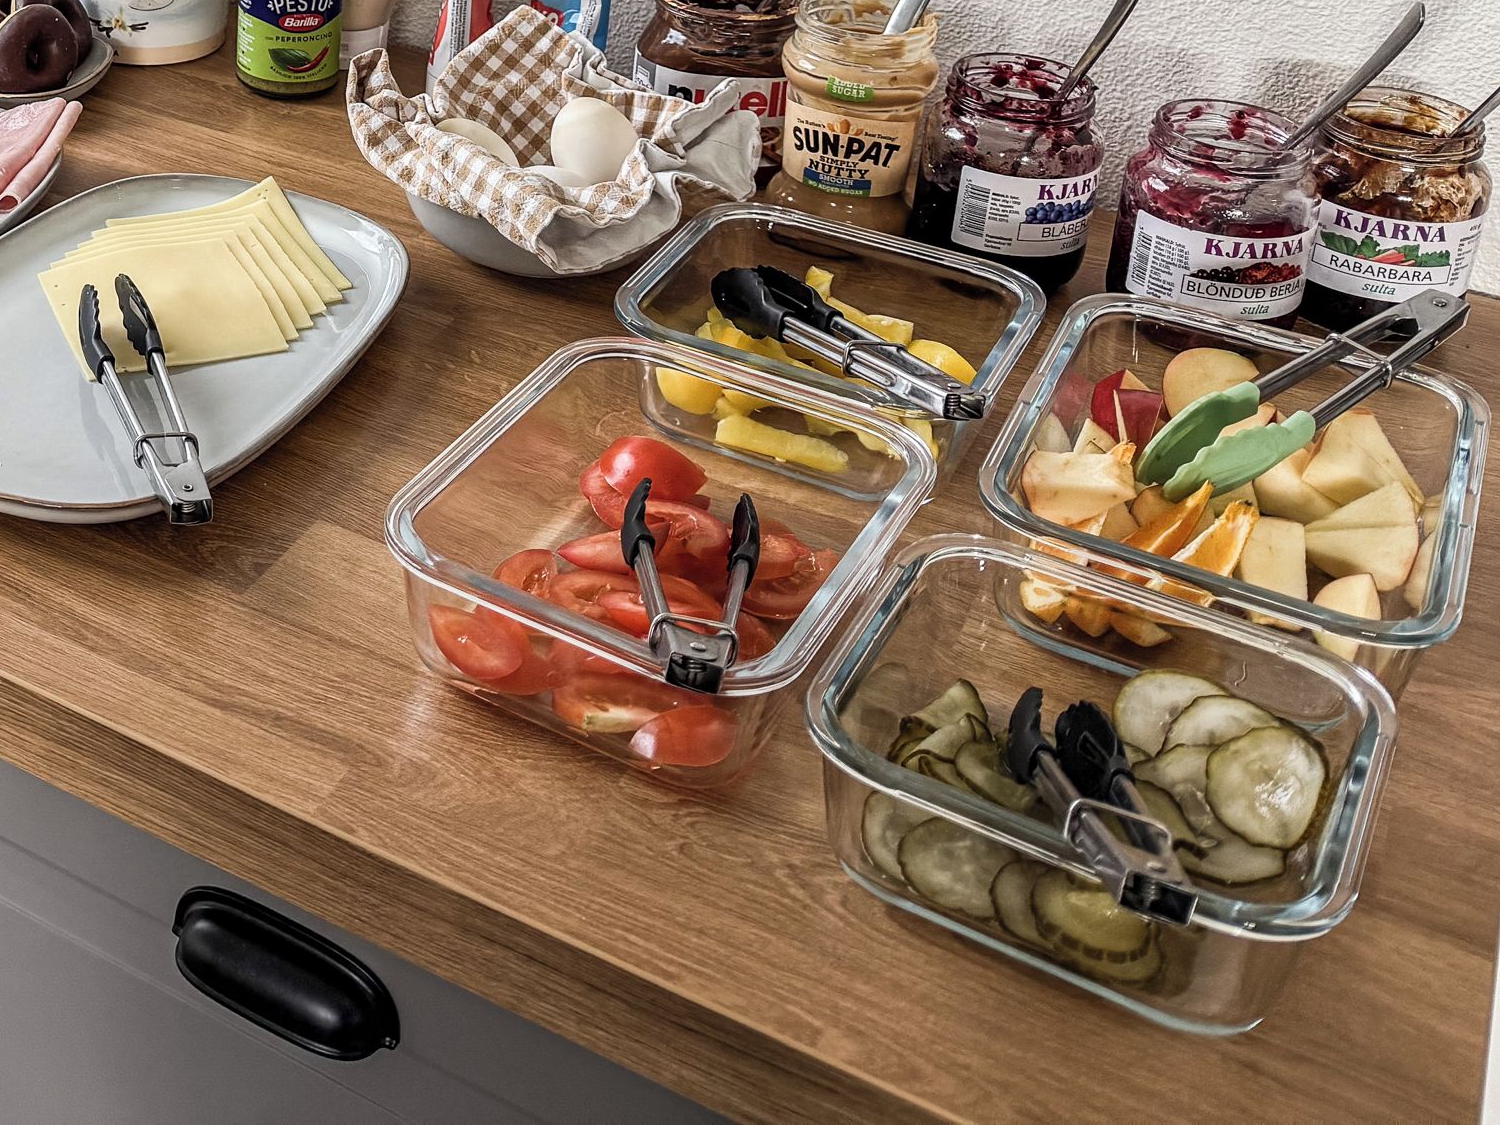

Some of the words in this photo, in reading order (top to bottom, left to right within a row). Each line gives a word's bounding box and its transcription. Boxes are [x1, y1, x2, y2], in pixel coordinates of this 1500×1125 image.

[284, 16, 320, 27] Barilla
[275, 31, 333, 43] PEPERONCINO
[832, 85, 866, 98] SUGAR
[819, 155, 858, 168] SIMPLY
[808, 158, 869, 179] NUTTY
[819, 174, 853, 186] SMOOTH
[1334, 208, 1446, 243] KJARNA
[1203, 237, 1303, 259] KJARNA
[1329, 254, 1432, 282] RABARBARA
[1186, 280, 1266, 299] BLÖNDUÐ
[1362, 283, 1396, 295] sulta
[1240, 304, 1270, 315] sulta
